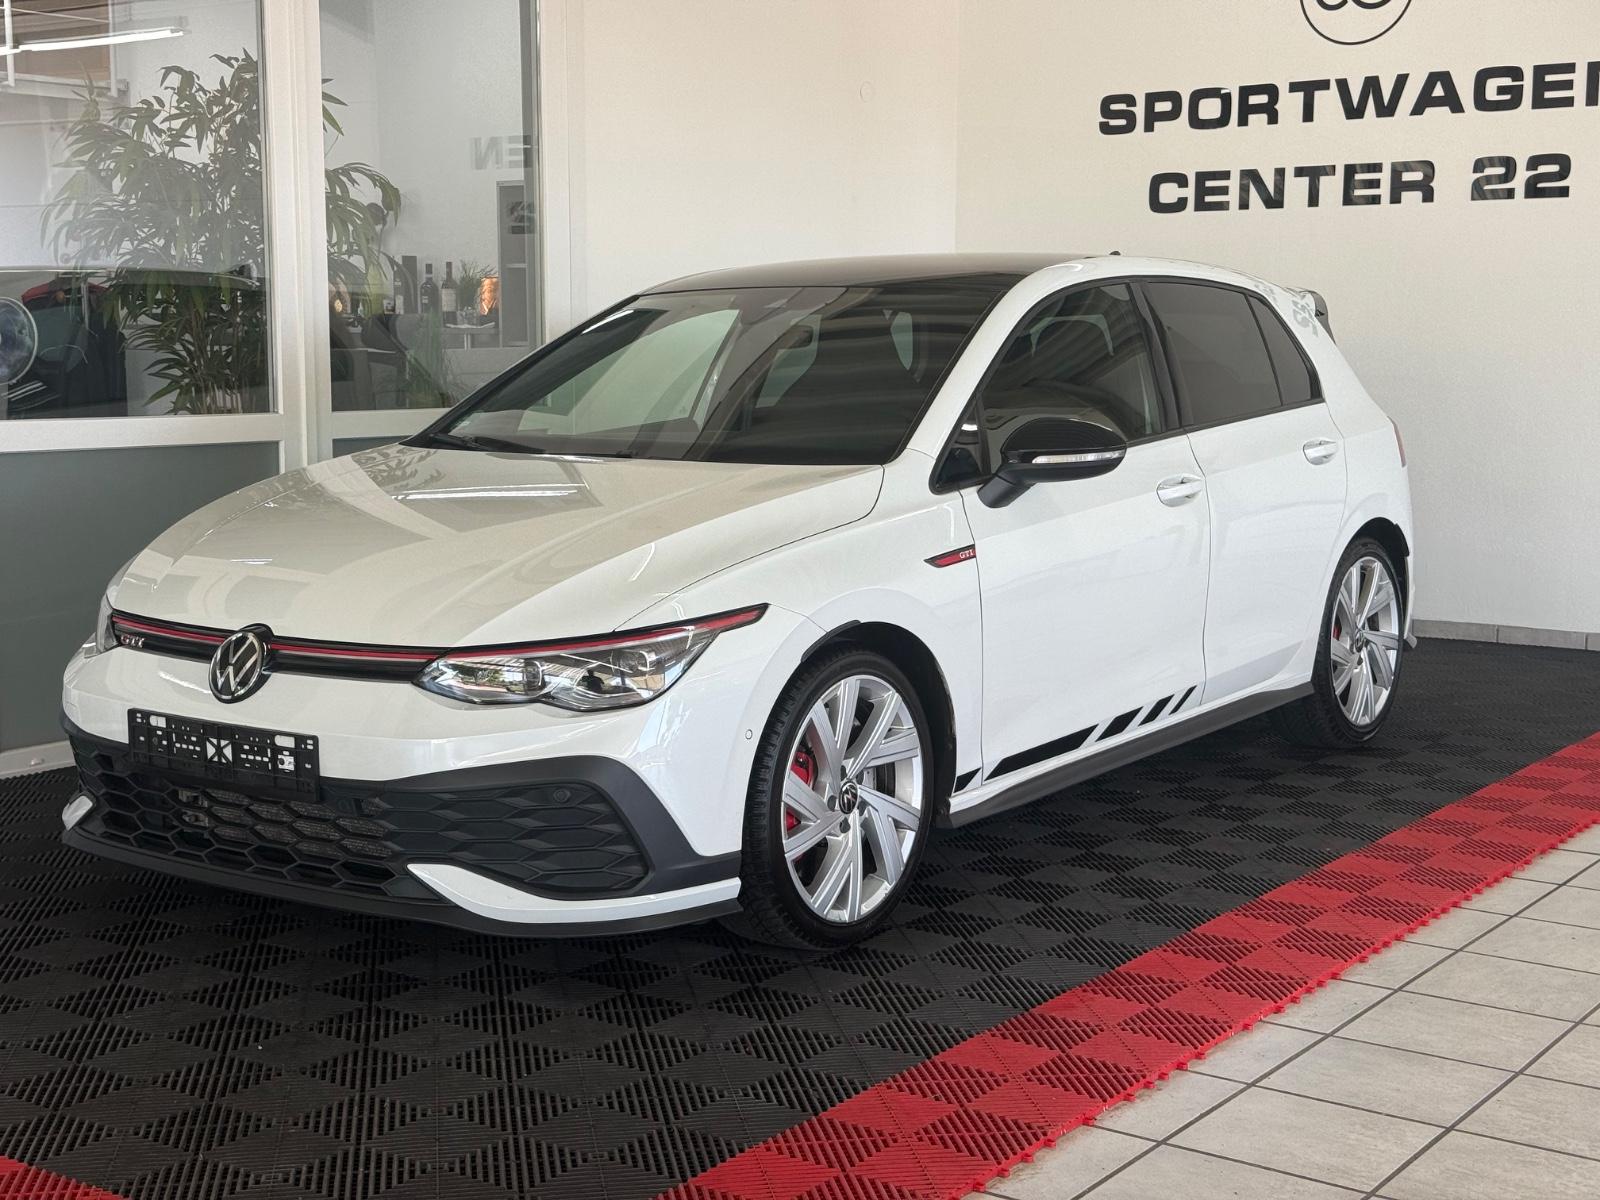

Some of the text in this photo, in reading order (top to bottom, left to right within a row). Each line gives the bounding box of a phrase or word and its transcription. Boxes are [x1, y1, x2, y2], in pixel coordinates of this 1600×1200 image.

[1149, 153, 1572, 214] CENTER 22
[959, 549, 974, 559] GTI
[120, 633, 145, 648] GTI
